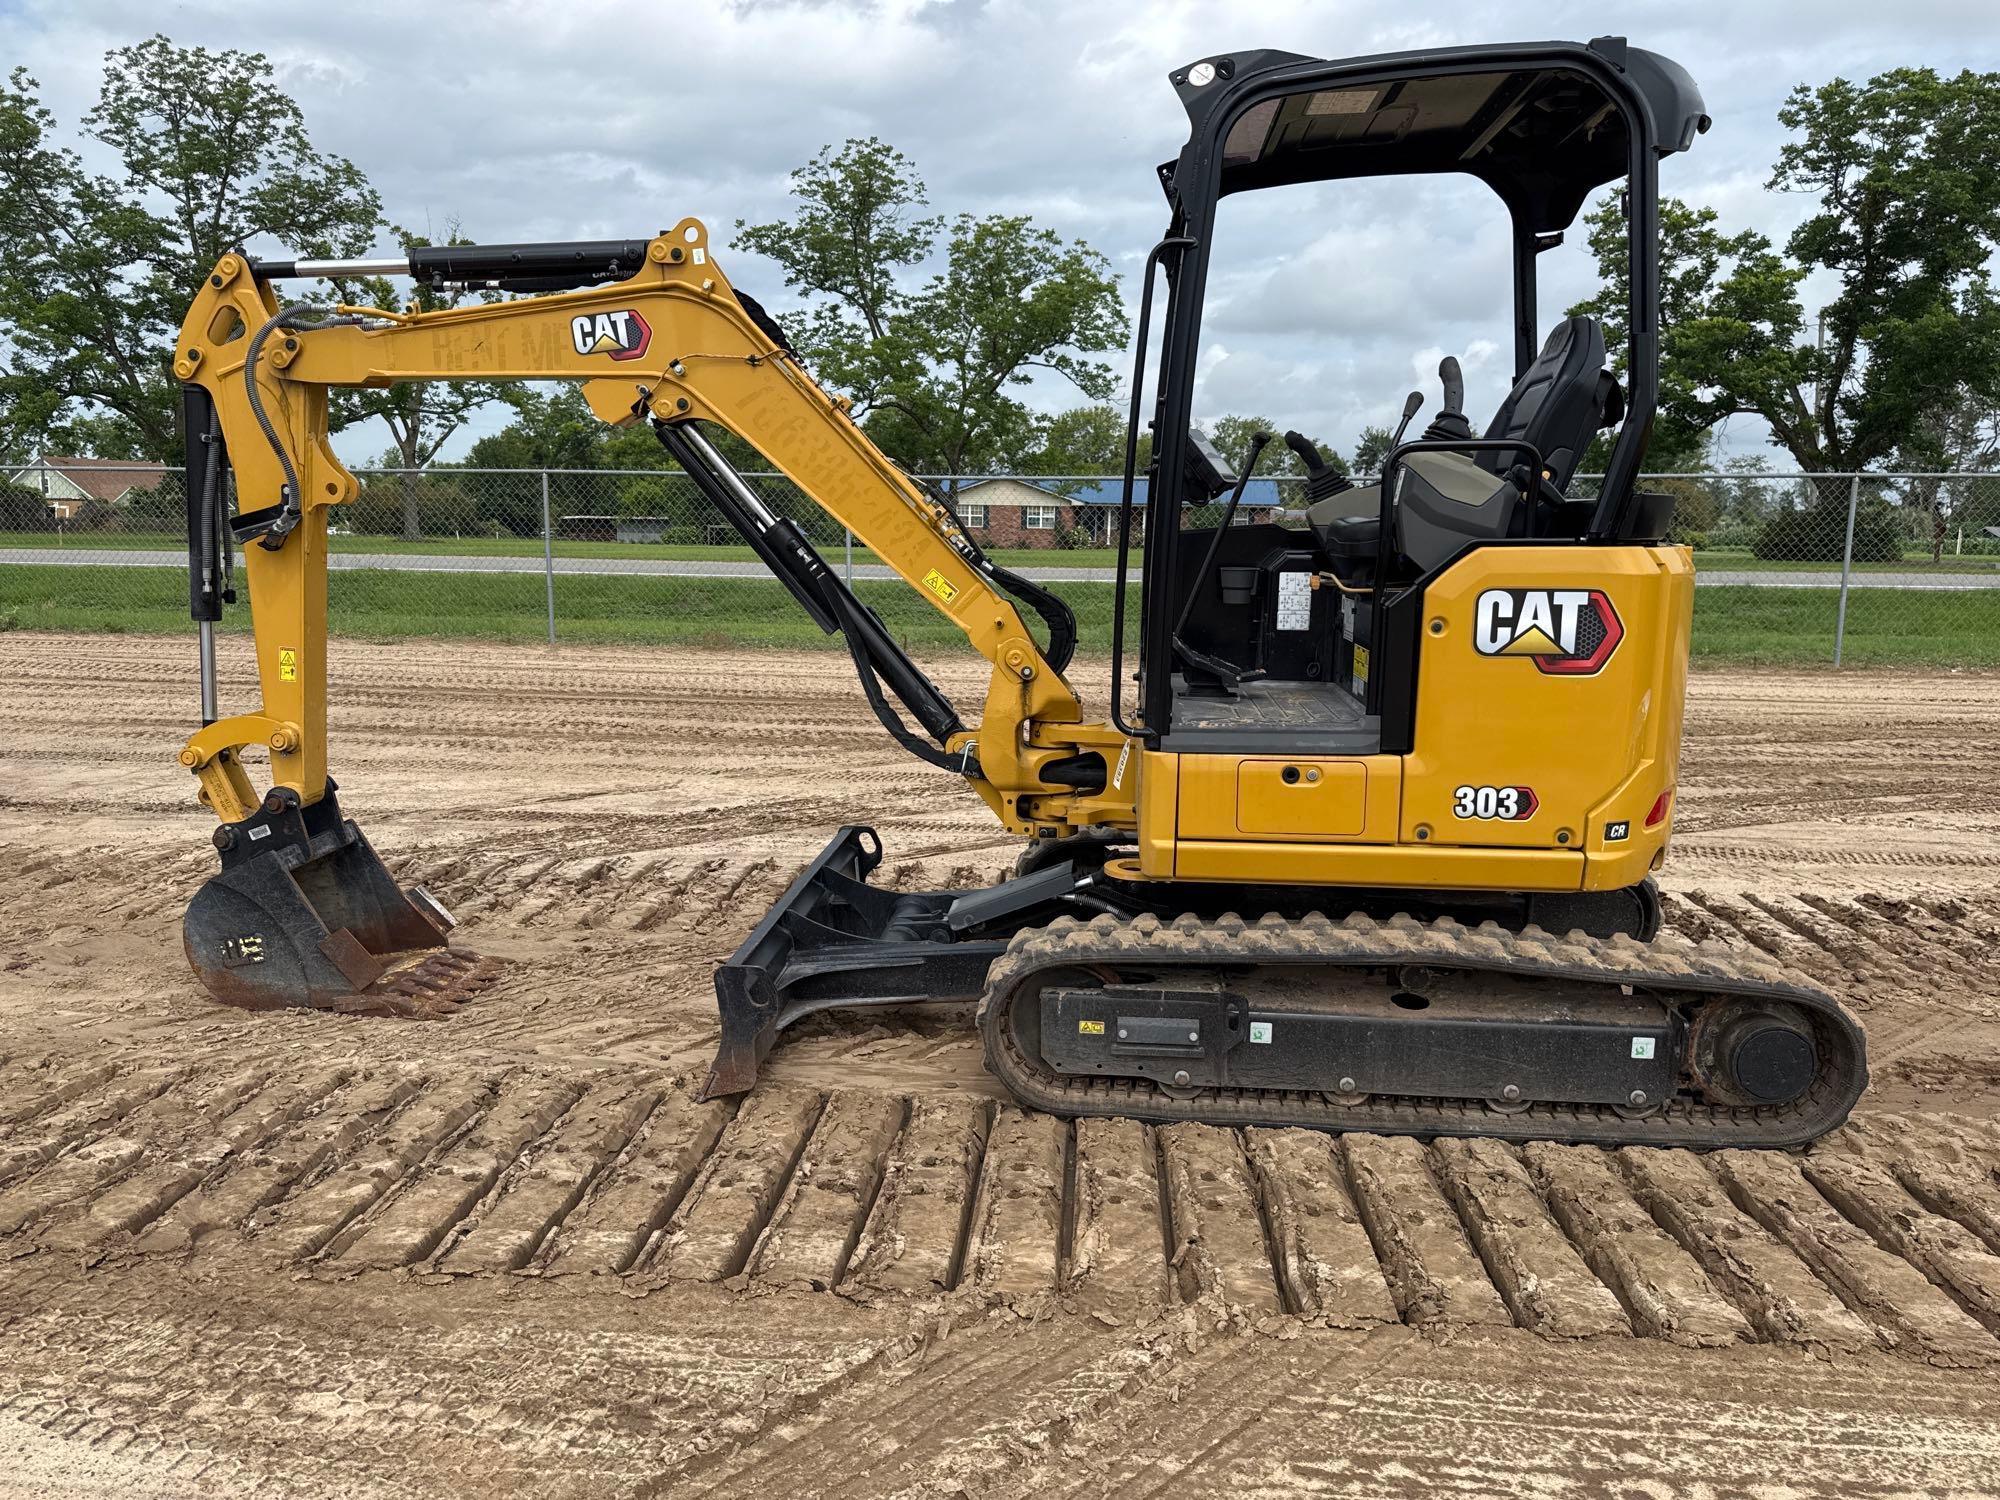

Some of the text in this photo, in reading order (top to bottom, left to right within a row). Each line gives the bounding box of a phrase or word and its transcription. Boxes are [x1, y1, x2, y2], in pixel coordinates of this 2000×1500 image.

[573, 311, 630, 354] CAT
[1476, 590, 1589, 655] CAT
[1455, 786, 1519, 818] 303
[1610, 825, 1626, 838] CR
